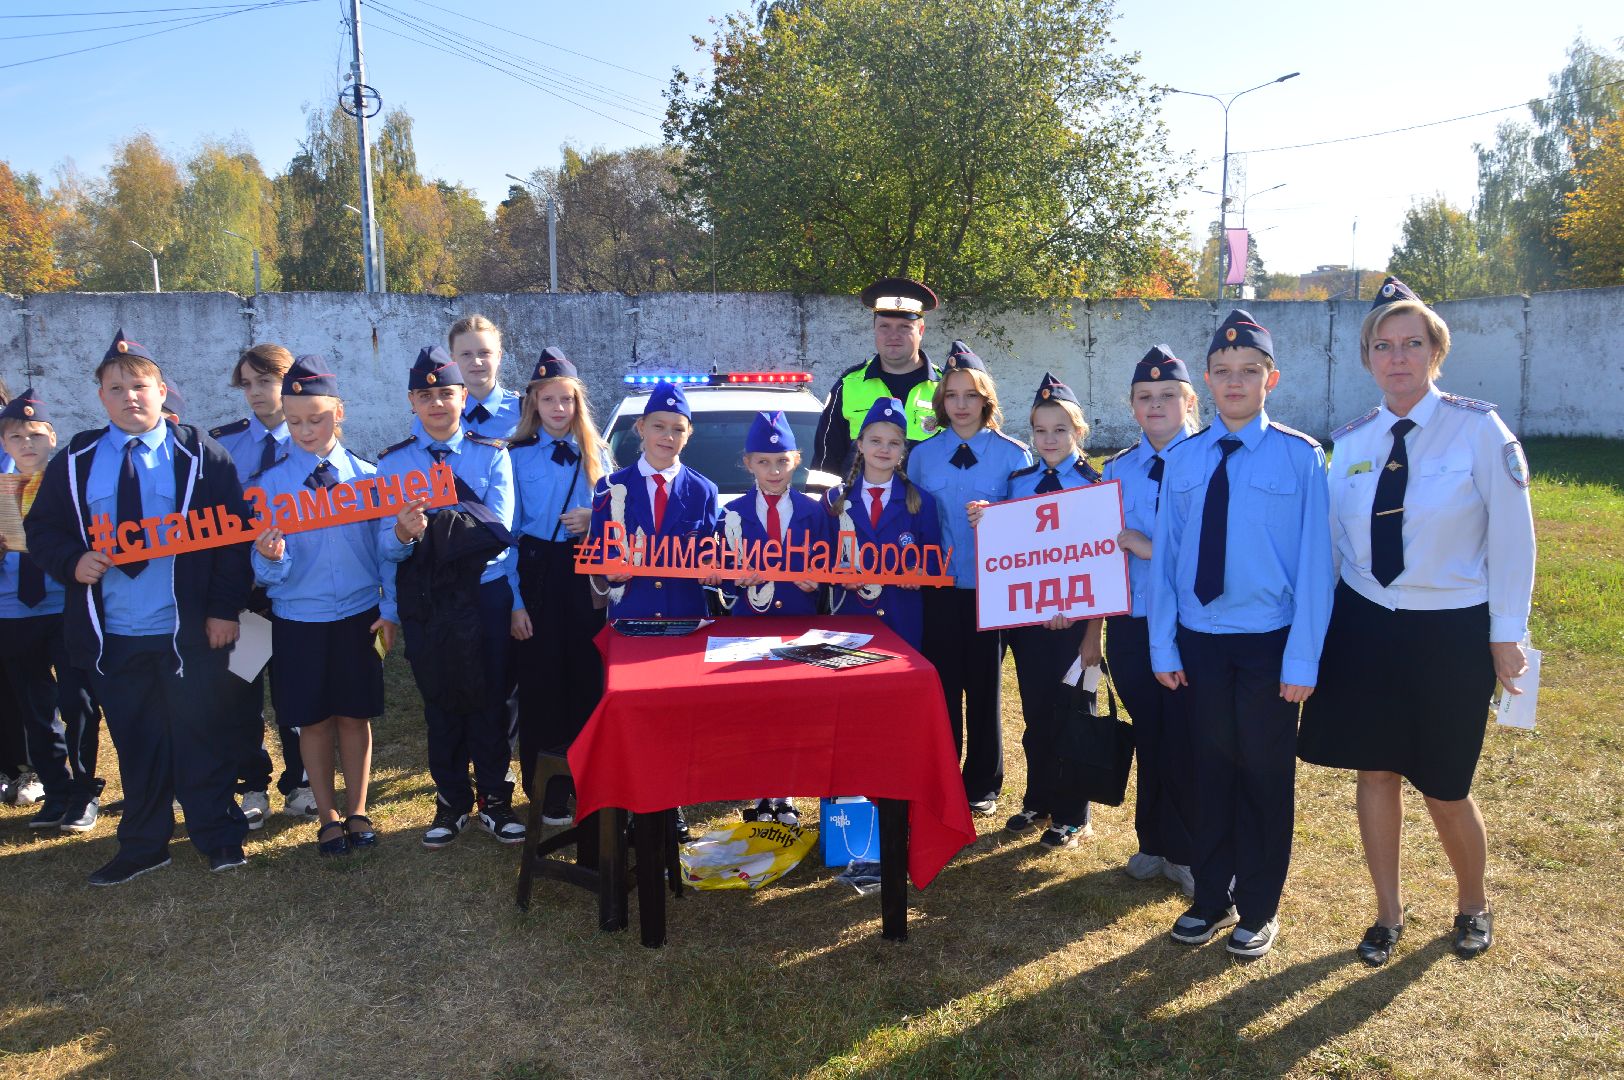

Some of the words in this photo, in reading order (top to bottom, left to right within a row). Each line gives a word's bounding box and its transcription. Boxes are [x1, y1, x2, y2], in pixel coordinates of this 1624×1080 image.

[88, 461, 458, 558] #станьЗаметней
[1036, 502, 1060, 533] Я
[573, 520, 955, 587] #ВниманиеНаДорогу
[985, 539, 1116, 573] СОБЛЮДАЮ
[1008, 574, 1095, 614] ПДД
[749, 827, 796, 848] Яндекс
